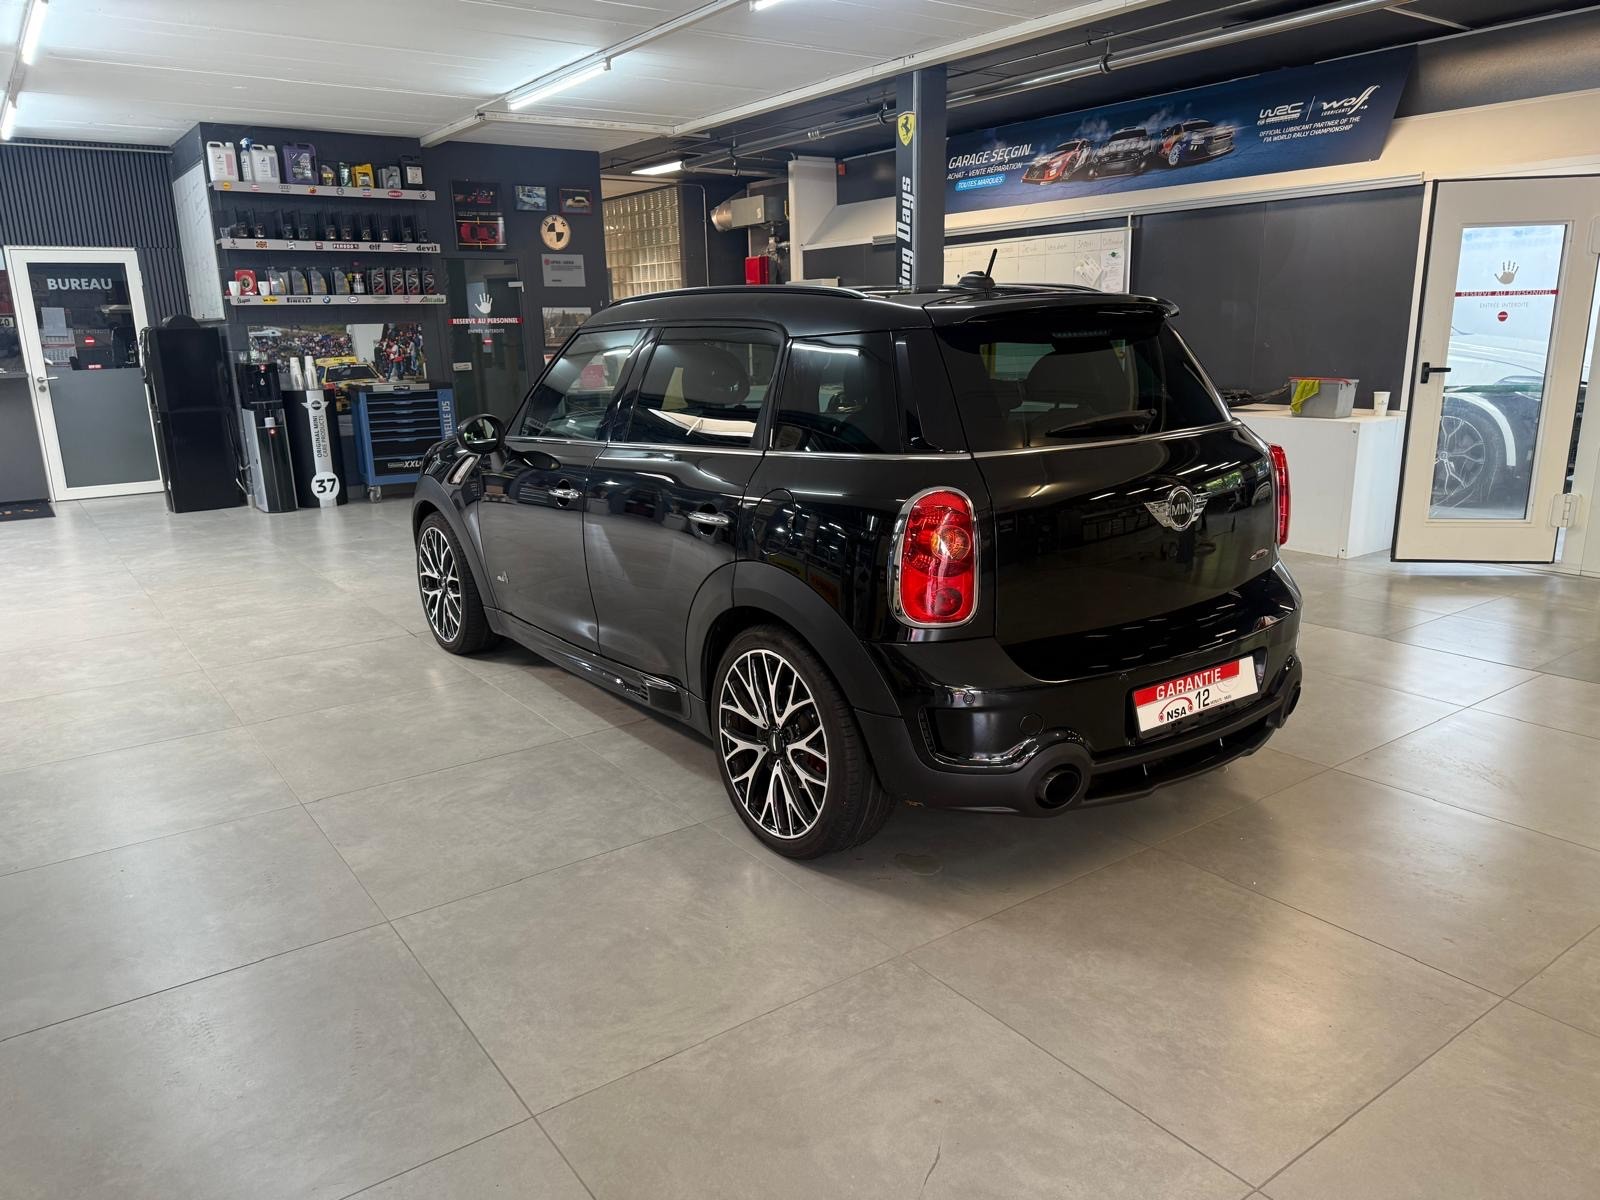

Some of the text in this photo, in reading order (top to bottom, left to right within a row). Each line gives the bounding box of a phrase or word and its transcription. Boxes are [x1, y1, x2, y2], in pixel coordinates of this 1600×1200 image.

[1259, 128, 1281, 137] OFFICIAL
[1282, 123, 1313, 133] LUBRICANT
[1313, 118, 1340, 129] PARTNER
[1340, 117, 1349, 125] OF
[1272, 132, 1292, 142] WORLD
[1292, 130, 1310, 139] RALLY
[1309, 123, 1353, 136] CHAMPIONSHIP
[948, 143, 1032, 169] GARAGE SEÇGIN
[946, 171, 965, 180] ACHAT
[968, 167, 987, 177] VENTE
[986, 162, 1023, 174] RÉPARATION
[958, 175, 1004, 188] TOUTES MARQUES
[896, 175, 915, 243] Days
[46, 278, 112, 290] BUREAU
[487, 317, 518, 325] PERSONNEL
[318, 414, 328, 443] PRODUCTS
[314, 429, 323, 458] ORIGINAL
[315, 478, 336, 494] 37
[1171, 502, 1192, 516] MINI
[1156, 668, 1222, 700] GARANTIE
[1195, 689, 1210, 709] 12
[1166, 706, 1187, 721] NSA
